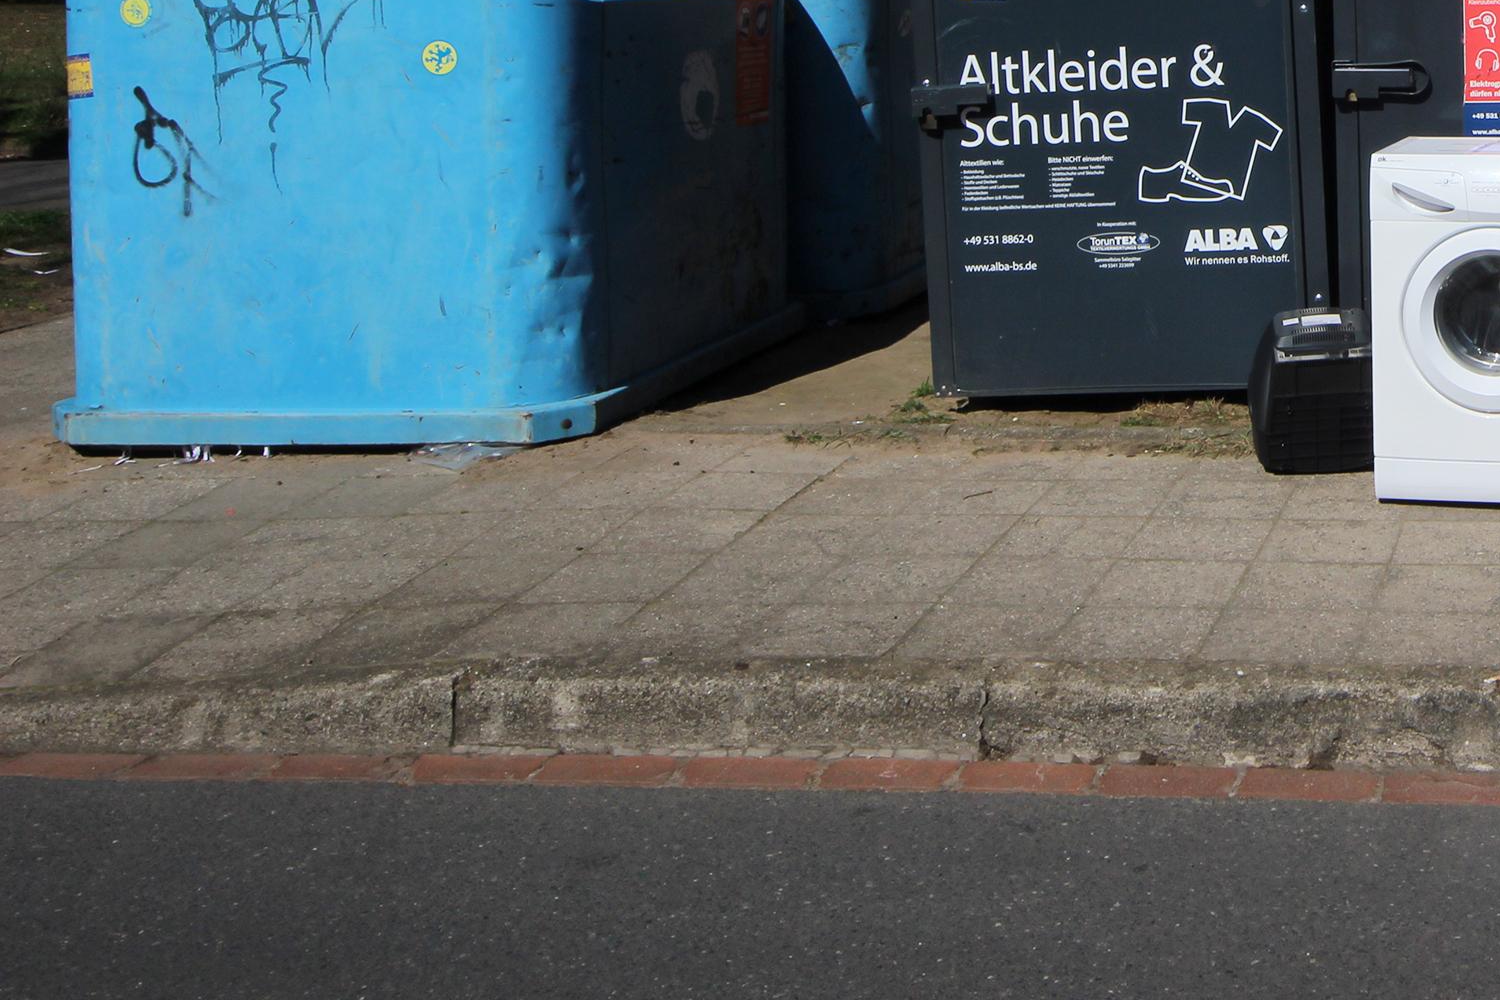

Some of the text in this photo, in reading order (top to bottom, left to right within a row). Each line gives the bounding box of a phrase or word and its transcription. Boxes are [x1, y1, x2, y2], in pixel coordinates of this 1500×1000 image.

[960, 44, 1225, 95] Altkleider &
[960, 100, 1130, 148] Schuhe
[963, 234, 1034, 245] +49 531 8862-0
[1090, 236, 1137, 246] TorunTEX
[1184, 227, 1258, 252] ALBA
[1184, 254, 1290, 266] Wir nennen es Rohstoff.
[965, 261, 1038, 272] www.alba-bs.de
